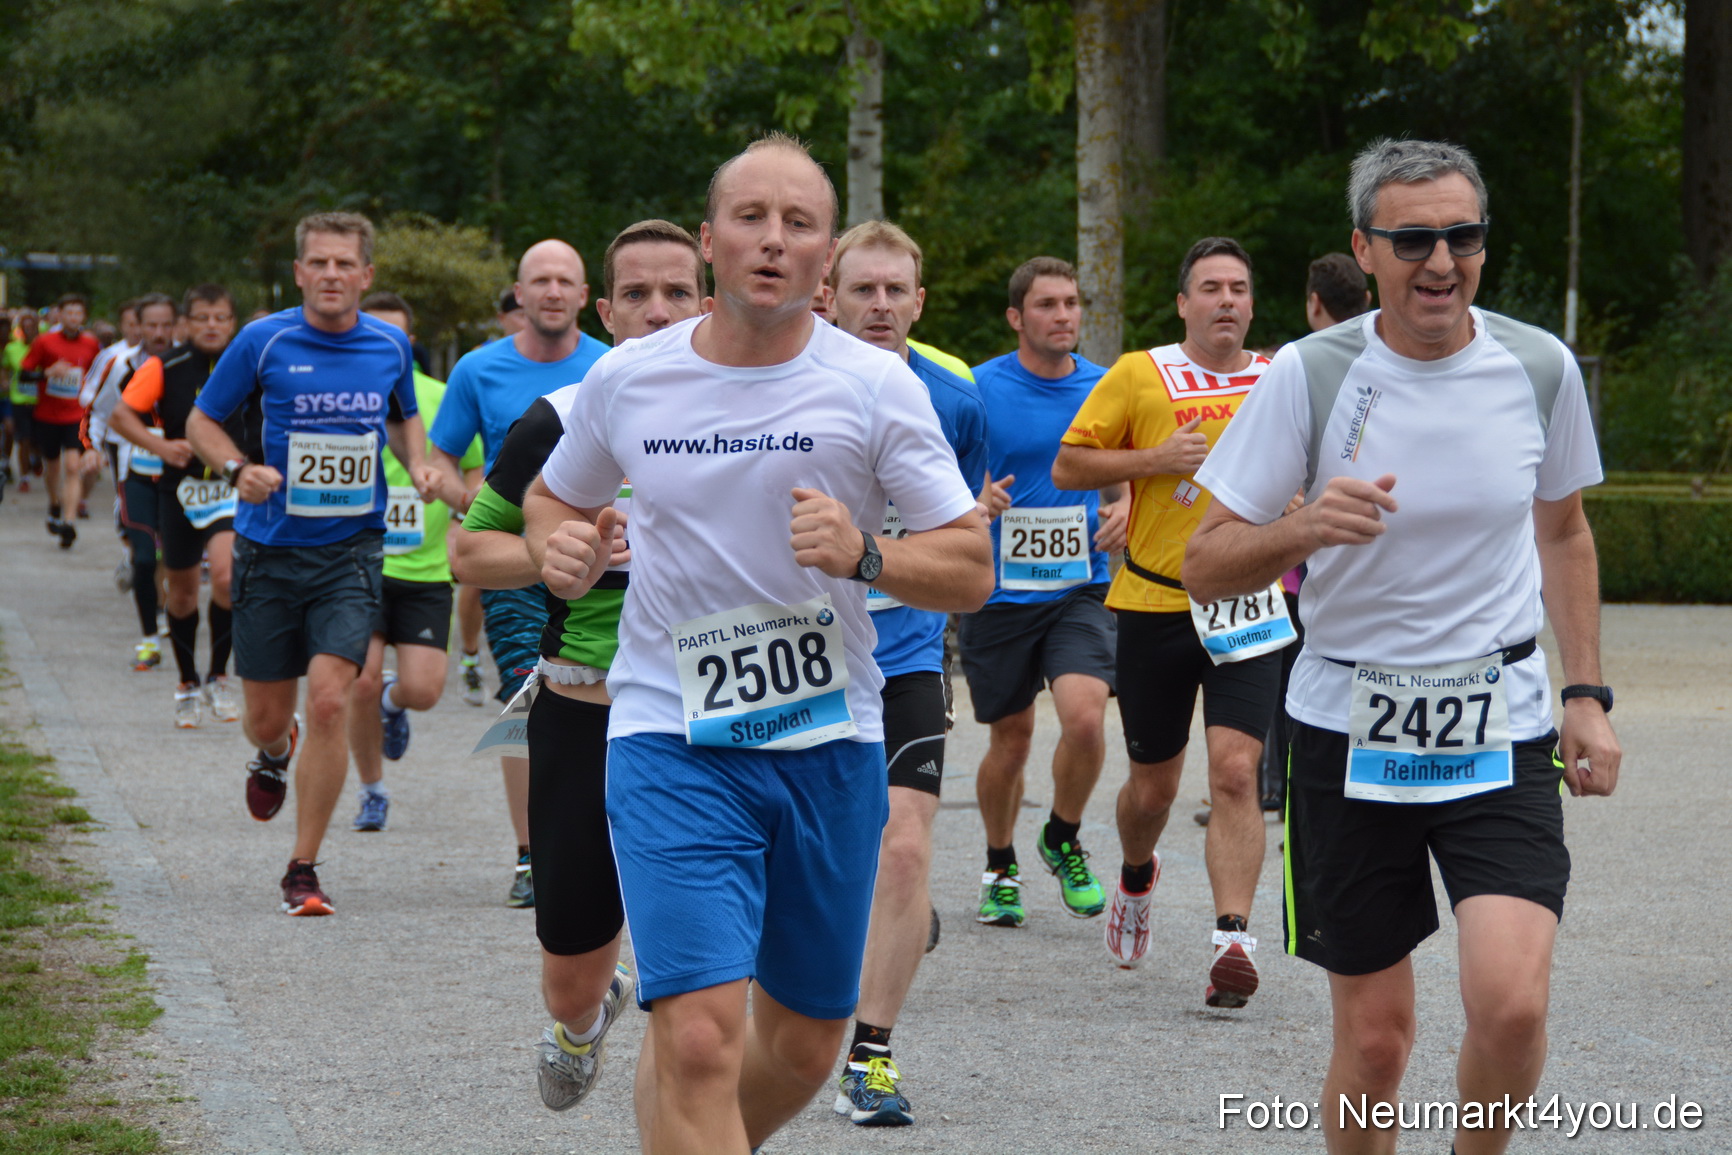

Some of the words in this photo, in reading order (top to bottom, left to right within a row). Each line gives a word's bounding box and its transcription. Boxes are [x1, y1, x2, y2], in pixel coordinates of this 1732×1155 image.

[294, 391, 382, 413] SYSCAD
[1174, 403, 1235, 427] MAX
[1340, 396, 1369, 462] SEEBERGER
[292, 441, 323, 451] PARTL
[643, 431, 814, 454] www.hasit.de
[298, 454, 371, 484] 2590
[320, 492, 350, 504] Marc
[1004, 515, 1033, 525] PARTL
[1035, 515, 1074, 525] Neumarkt
[1011, 527, 1081, 558] 2585
[1031, 566, 1063, 578] Franz
[678, 628, 731, 652] PARTL
[733, 615, 810, 639] Neumarkt
[1227, 628, 1272, 649] Dietmar
[697, 631, 833, 712] 2508
[1357, 668, 1406, 687] PARTL
[1410, 672, 1480, 688] Neumarkt
[692, 711, 699, 719] B
[730, 707, 813, 743] Stephan
[1367, 691, 1492, 749] 2427
[1356, 738, 1364, 747] A
[917, 767, 939, 777] adidas
[1383, 758, 1475, 781] Reinhard
